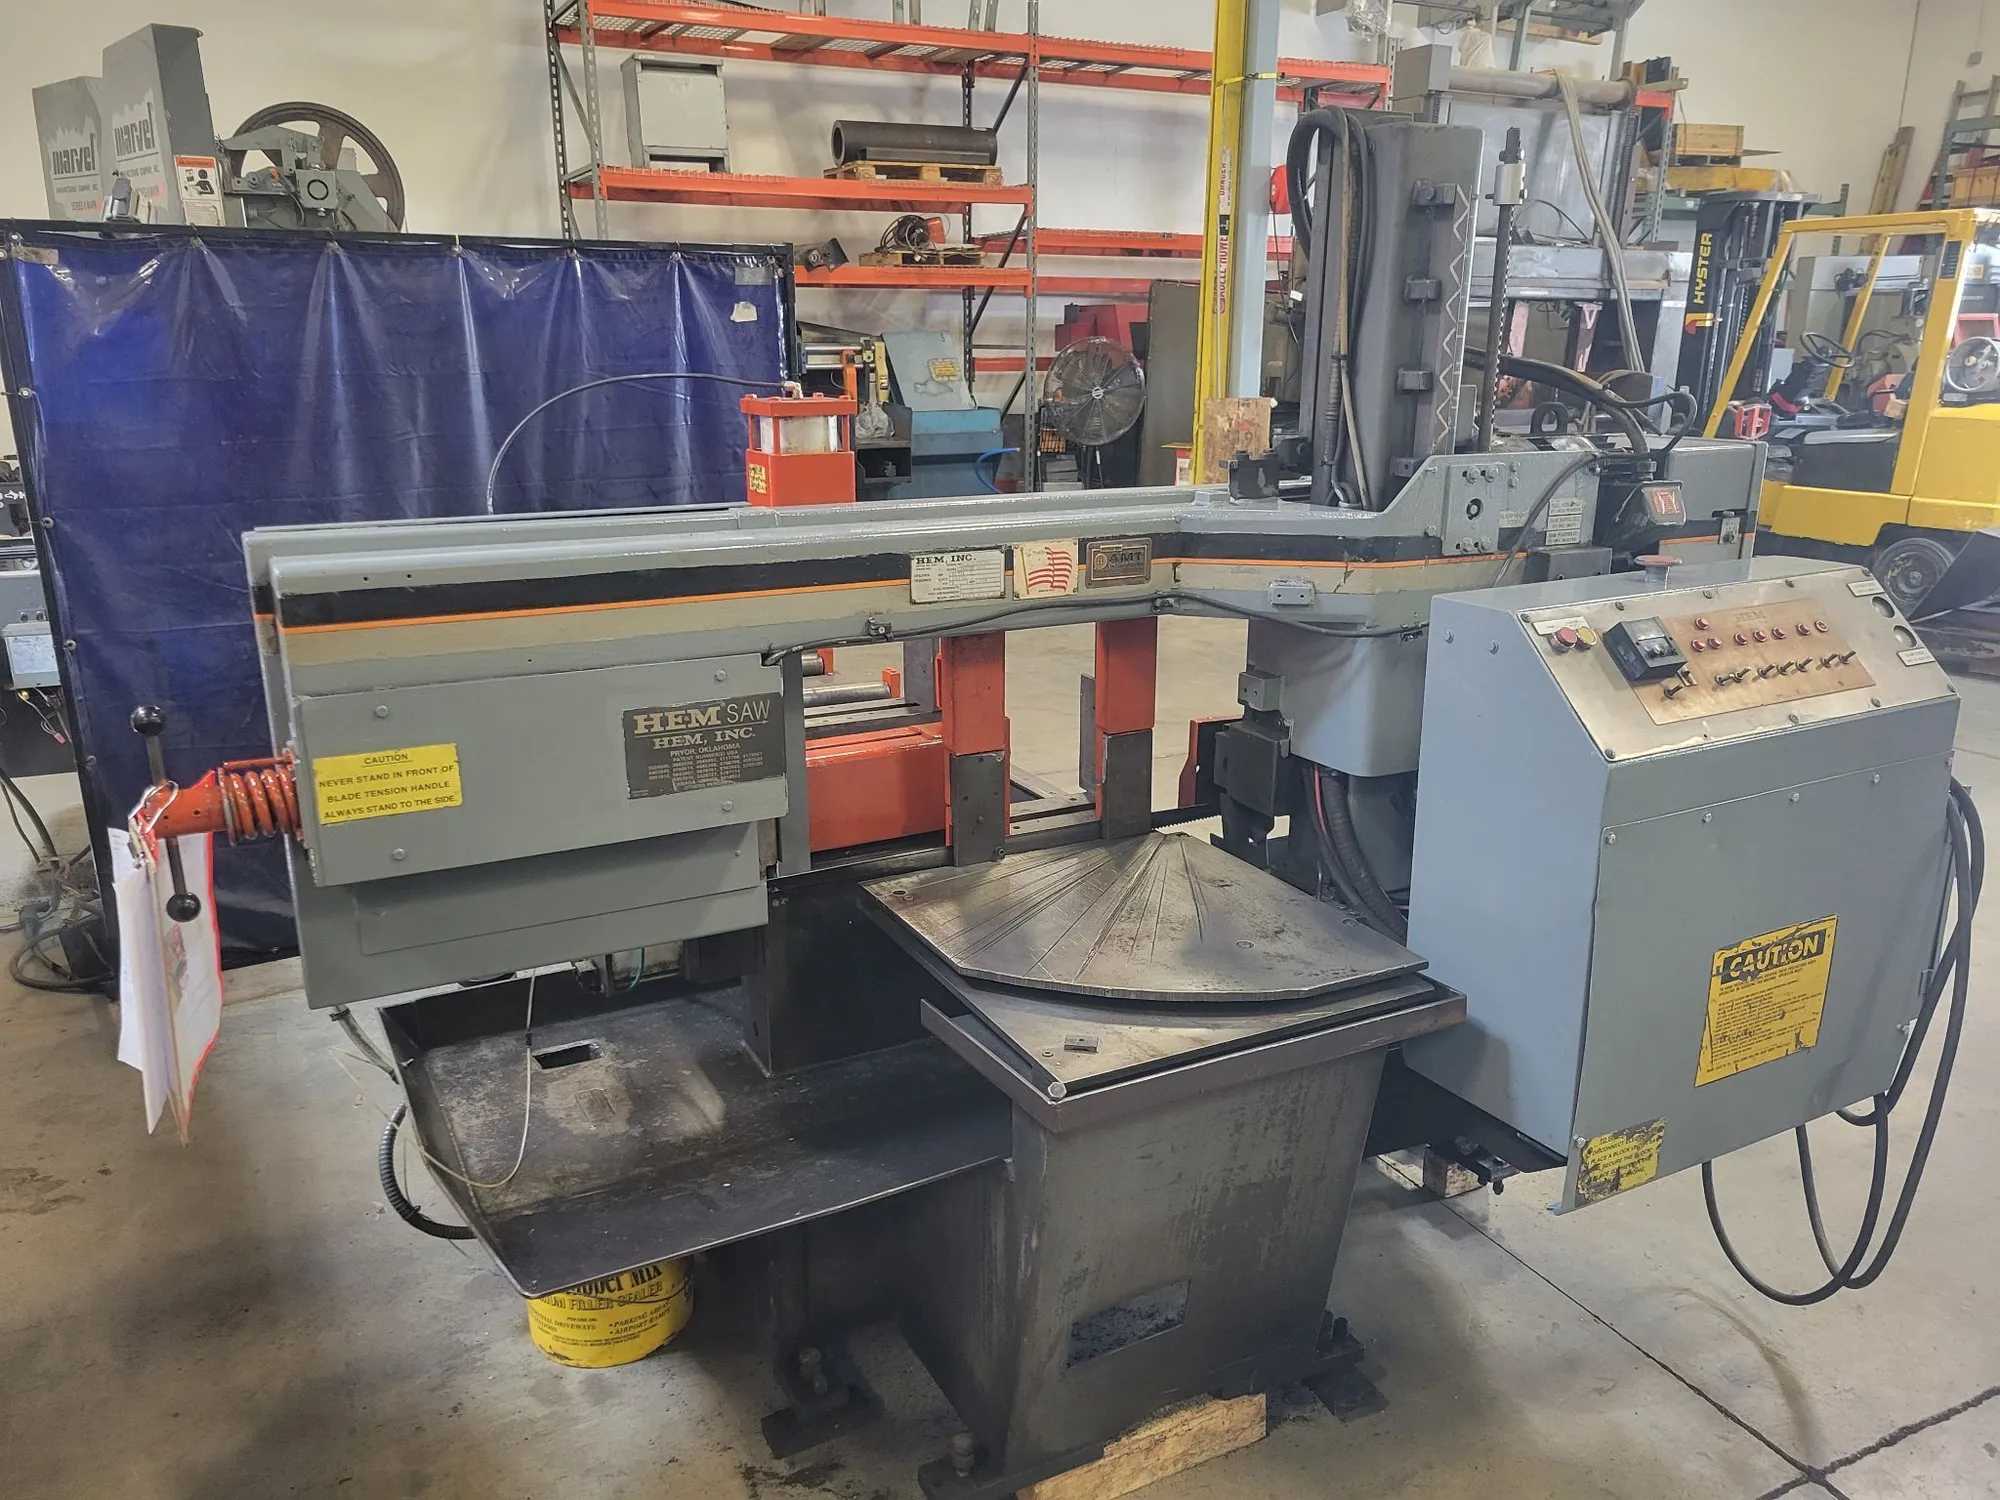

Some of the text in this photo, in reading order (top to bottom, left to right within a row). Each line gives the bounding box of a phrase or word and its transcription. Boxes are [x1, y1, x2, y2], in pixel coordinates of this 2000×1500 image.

[1694, 233, 1712, 304] HYSTER
[951, 554, 977, 562] INC.
[633, 700, 770, 735] HEM SAW
[652, 727, 756, 750] HEM, INC.
[698, 743, 740, 753] OKLAHOMA
[364, 753, 408, 765] CAUTION
[319, 777, 354, 788] NEVER
[356, 773, 390, 783] STAND
[405, 767, 438, 777] FRONT
[441, 765, 455, 773] OF
[327, 781, 450, 803] BLADE TENSION HANDLE
[324, 807, 365, 818] ALWAYS
[366, 803, 398, 813] STAND
[400, 800, 413, 808] TO
[415, 798, 433, 807] THE
[1729, 934, 1819, 978] CAUTION
